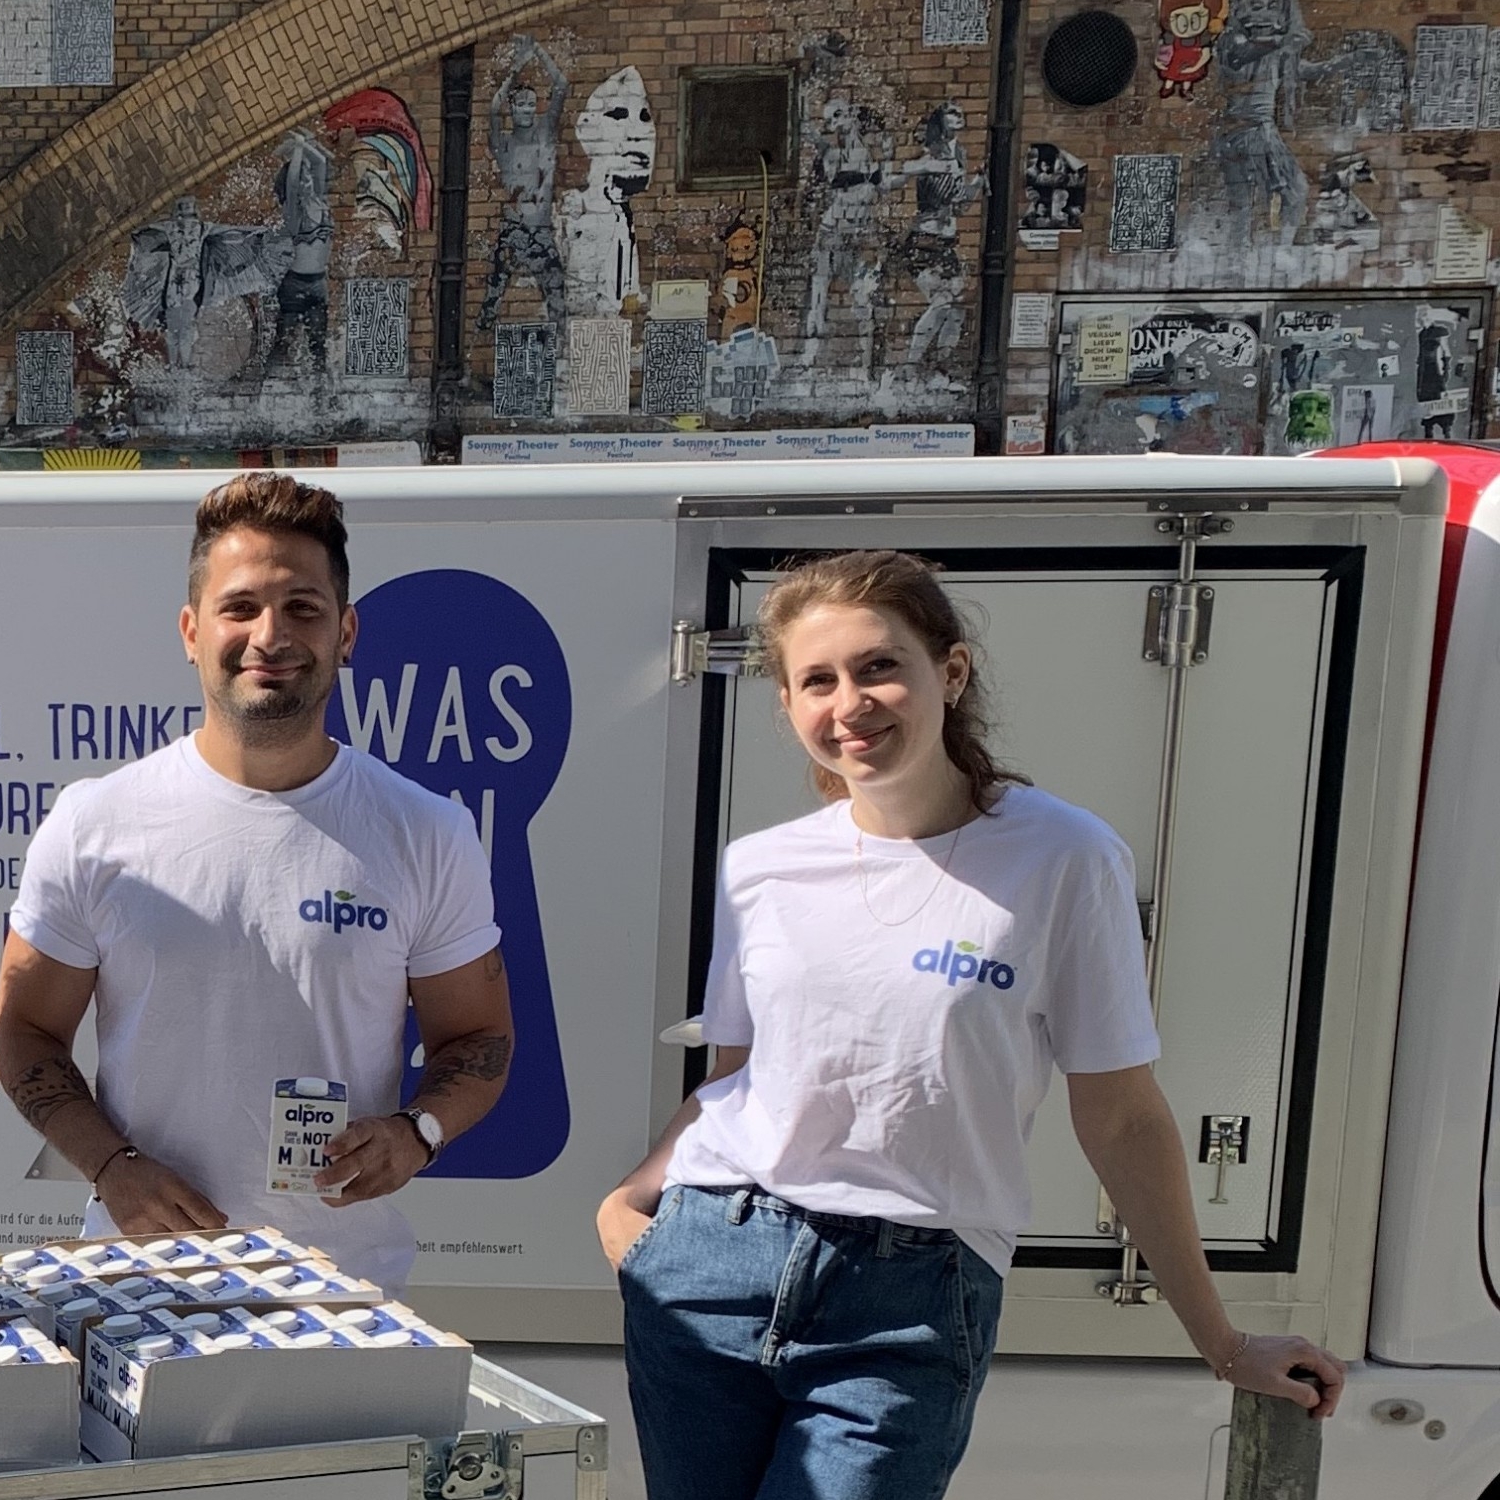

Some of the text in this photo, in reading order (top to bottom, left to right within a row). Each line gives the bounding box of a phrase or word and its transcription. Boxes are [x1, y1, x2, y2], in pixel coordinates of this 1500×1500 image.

[776, 434, 869, 445] Sommer Theater
[875, 429, 971, 440] Sommer Theater
[468, 440, 559, 451] Sommer Theater
[569, 438, 663, 449] Sommer Theater
[672, 438, 767, 448] Sommer Theater
[339, 664, 534, 764] WAS
[299, 889, 388, 935] alpro
[912, 939, 1015, 990] alpro
[285, 1104, 334, 1128] alpro
[303, 1132, 332, 1146] NOT
[17, 1213, 34, 1225] für
[38, 1213, 53, 1225] die
[118, 1362, 138, 1391] alpro
